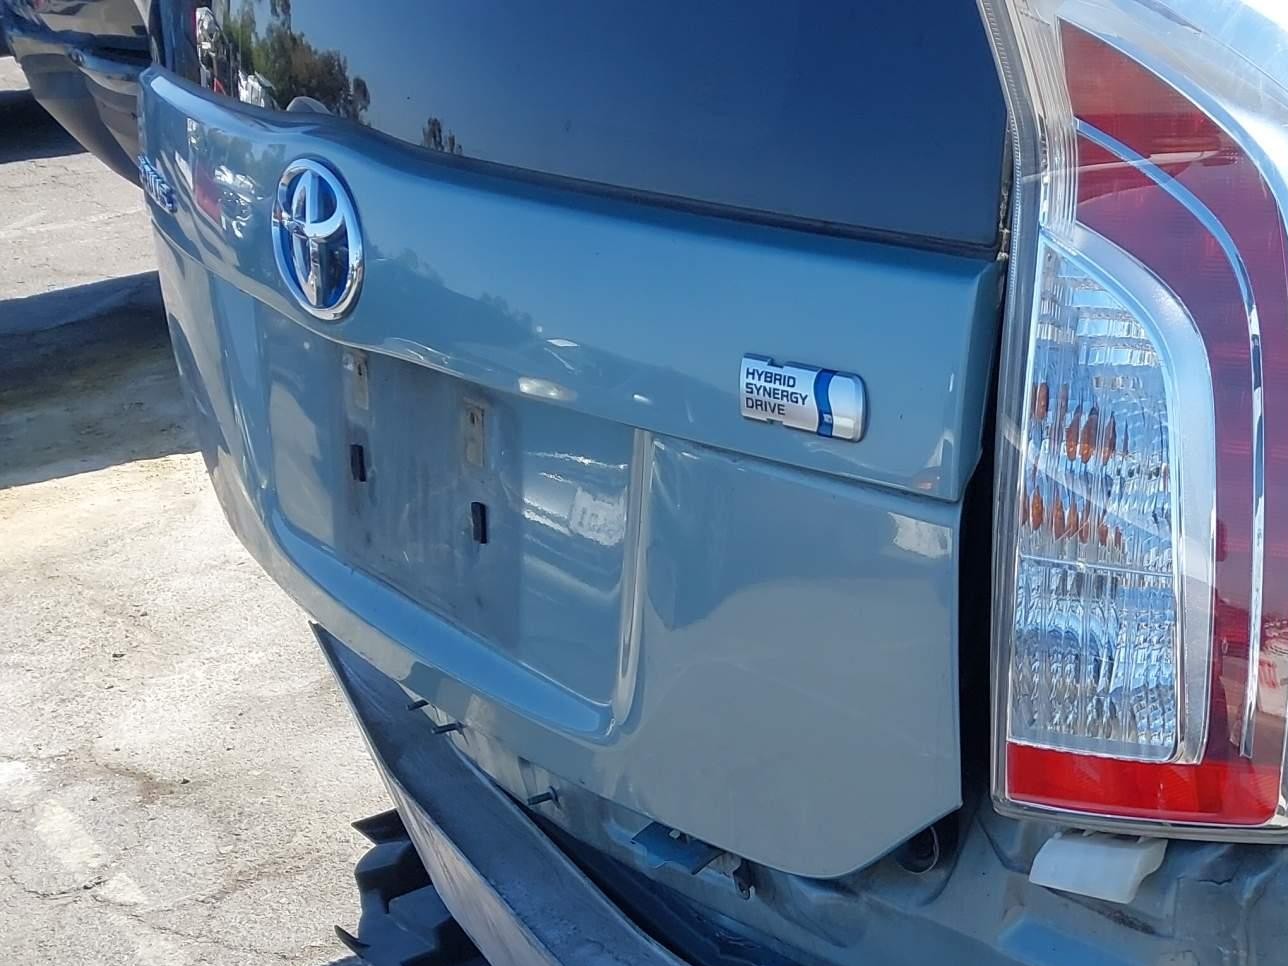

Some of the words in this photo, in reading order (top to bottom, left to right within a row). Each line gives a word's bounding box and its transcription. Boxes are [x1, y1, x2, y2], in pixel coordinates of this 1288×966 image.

[745, 367, 796, 389] HYBRID
[745, 382, 808, 406] SYNERGY
[745, 397, 786, 416] DRIVE
